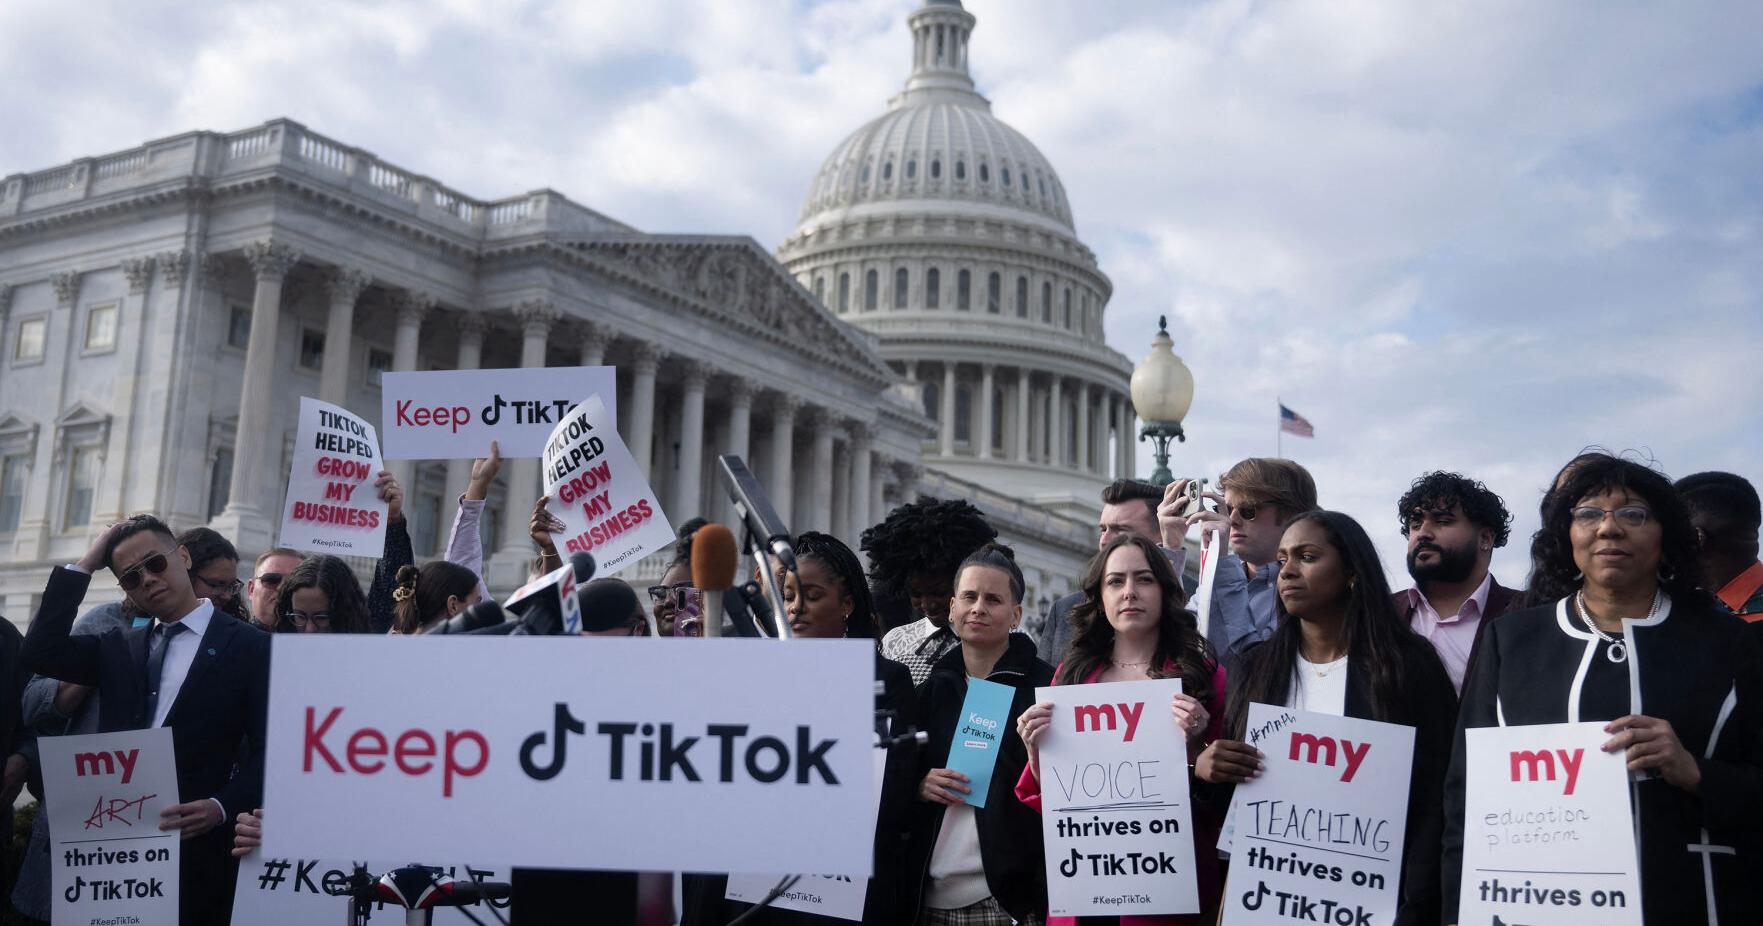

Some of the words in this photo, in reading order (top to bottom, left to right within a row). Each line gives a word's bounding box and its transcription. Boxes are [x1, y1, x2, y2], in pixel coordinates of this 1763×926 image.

[319, 409, 368, 440] TIKTOK
[396, 399, 471, 433] Keep
[511, 400, 579, 424] TikT
[315, 432, 373, 459] HELPED
[547, 412, 594, 458] TIKTOK
[317, 456, 372, 480] GROW
[548, 436, 605, 485] HELPED
[325, 481, 357, 501] MY
[558, 460, 612, 504] GROW
[293, 501, 380, 529] BUSINESS
[582, 490, 613, 521] MY
[565, 498, 653, 553] BUSINESS
[312, 538, 353, 549] #KeepTikTok
[603, 544, 644, 569] #KeepTikTok
[969, 712, 997, 730] Keep
[971, 728, 996, 741] TikTok
[1074, 702, 1145, 742] my
[74, 748, 140, 784] my
[302, 706, 490, 797] Keep
[598, 722, 841, 786] TikTok
[1288, 731, 1372, 783] my
[1052, 760, 1160, 802] VOICE
[1510, 748, 1585, 795] my
[84, 794, 157, 830] ART
[1247, 800, 1390, 853] TEACHING
[1484, 806, 1590, 826] education
[1057, 816, 1142, 838] thrives
[1149, 817, 1179, 834] on
[1486, 827, 1580, 852] platform
[64, 847, 139, 867] thrives
[145, 847, 170, 862] on
[1087, 852, 1178, 876] TikTok
[1248, 847, 1343, 882] thrives
[1351, 869, 1385, 890] on
[90, 877, 163, 901] TikTok
[1093, 894, 1152, 906] #KeepTikTok
[1479, 879, 1582, 907] thrives
[1590, 889, 1626, 907] on
[90, 916, 140, 926] #KeepTikTok
[1275, 891, 1374, 926] TikTok
